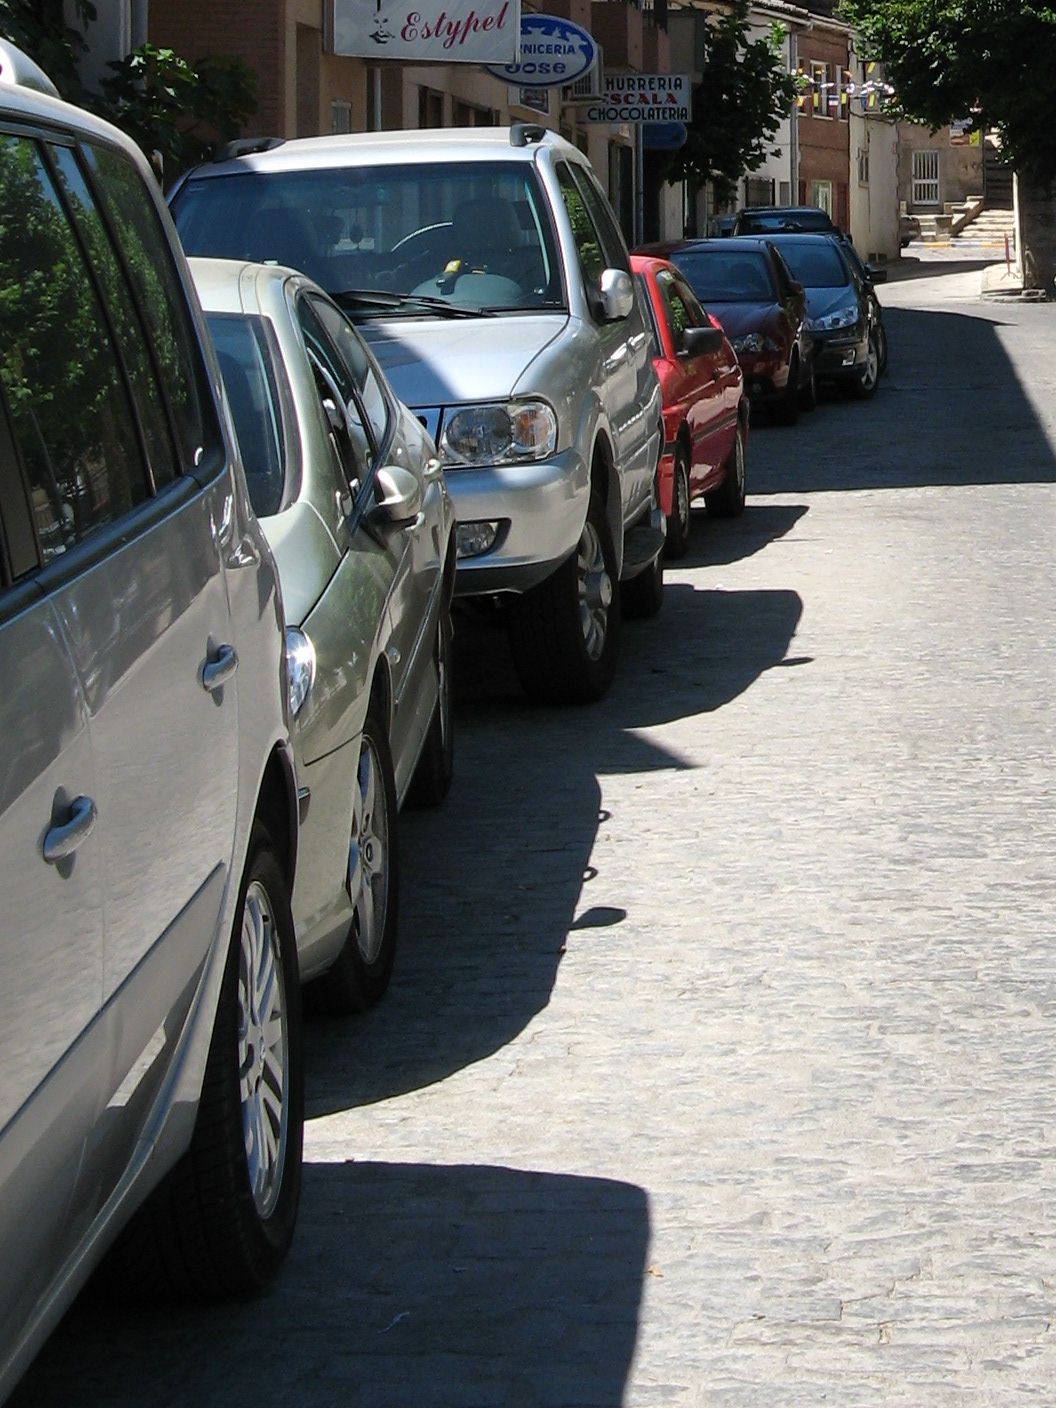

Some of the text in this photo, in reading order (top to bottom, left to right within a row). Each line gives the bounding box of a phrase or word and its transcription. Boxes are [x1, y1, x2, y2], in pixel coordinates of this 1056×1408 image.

[400, 0, 510, 50] Estypel
[519, 43, 576, 55] NICERIA
[505, 61, 567, 75] Jose
[605, 76, 683, 91] HURRERIA
[587, 106, 689, 121] CHOCOLATERIA
